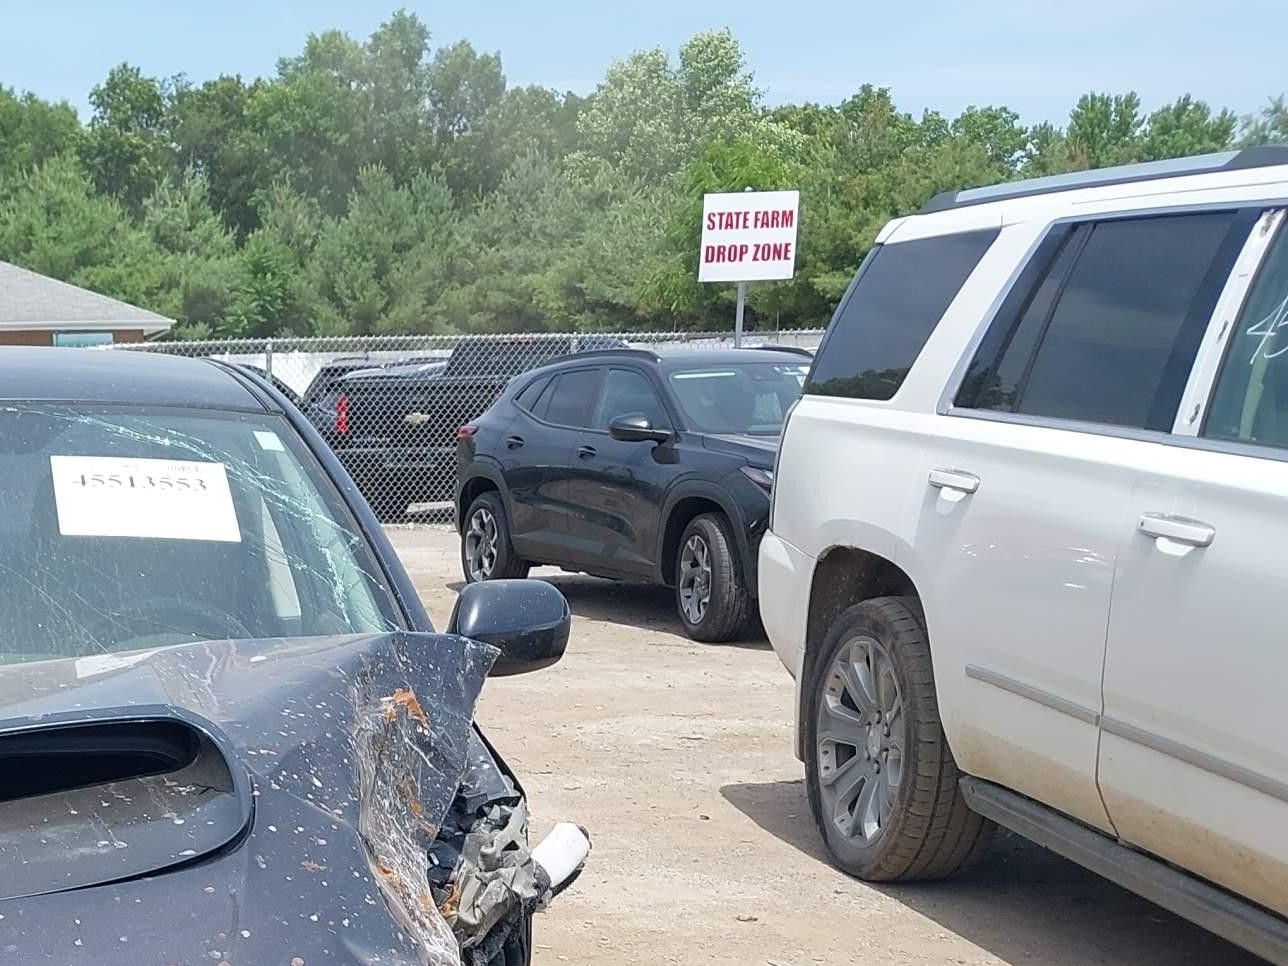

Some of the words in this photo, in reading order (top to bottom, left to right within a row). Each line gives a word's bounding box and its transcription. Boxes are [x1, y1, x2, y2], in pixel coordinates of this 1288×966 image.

[706, 211, 750, 230] STATE
[753, 210, 793, 228] FARM
[704, 244, 748, 263] DROP
[752, 243, 791, 261] ZONE
